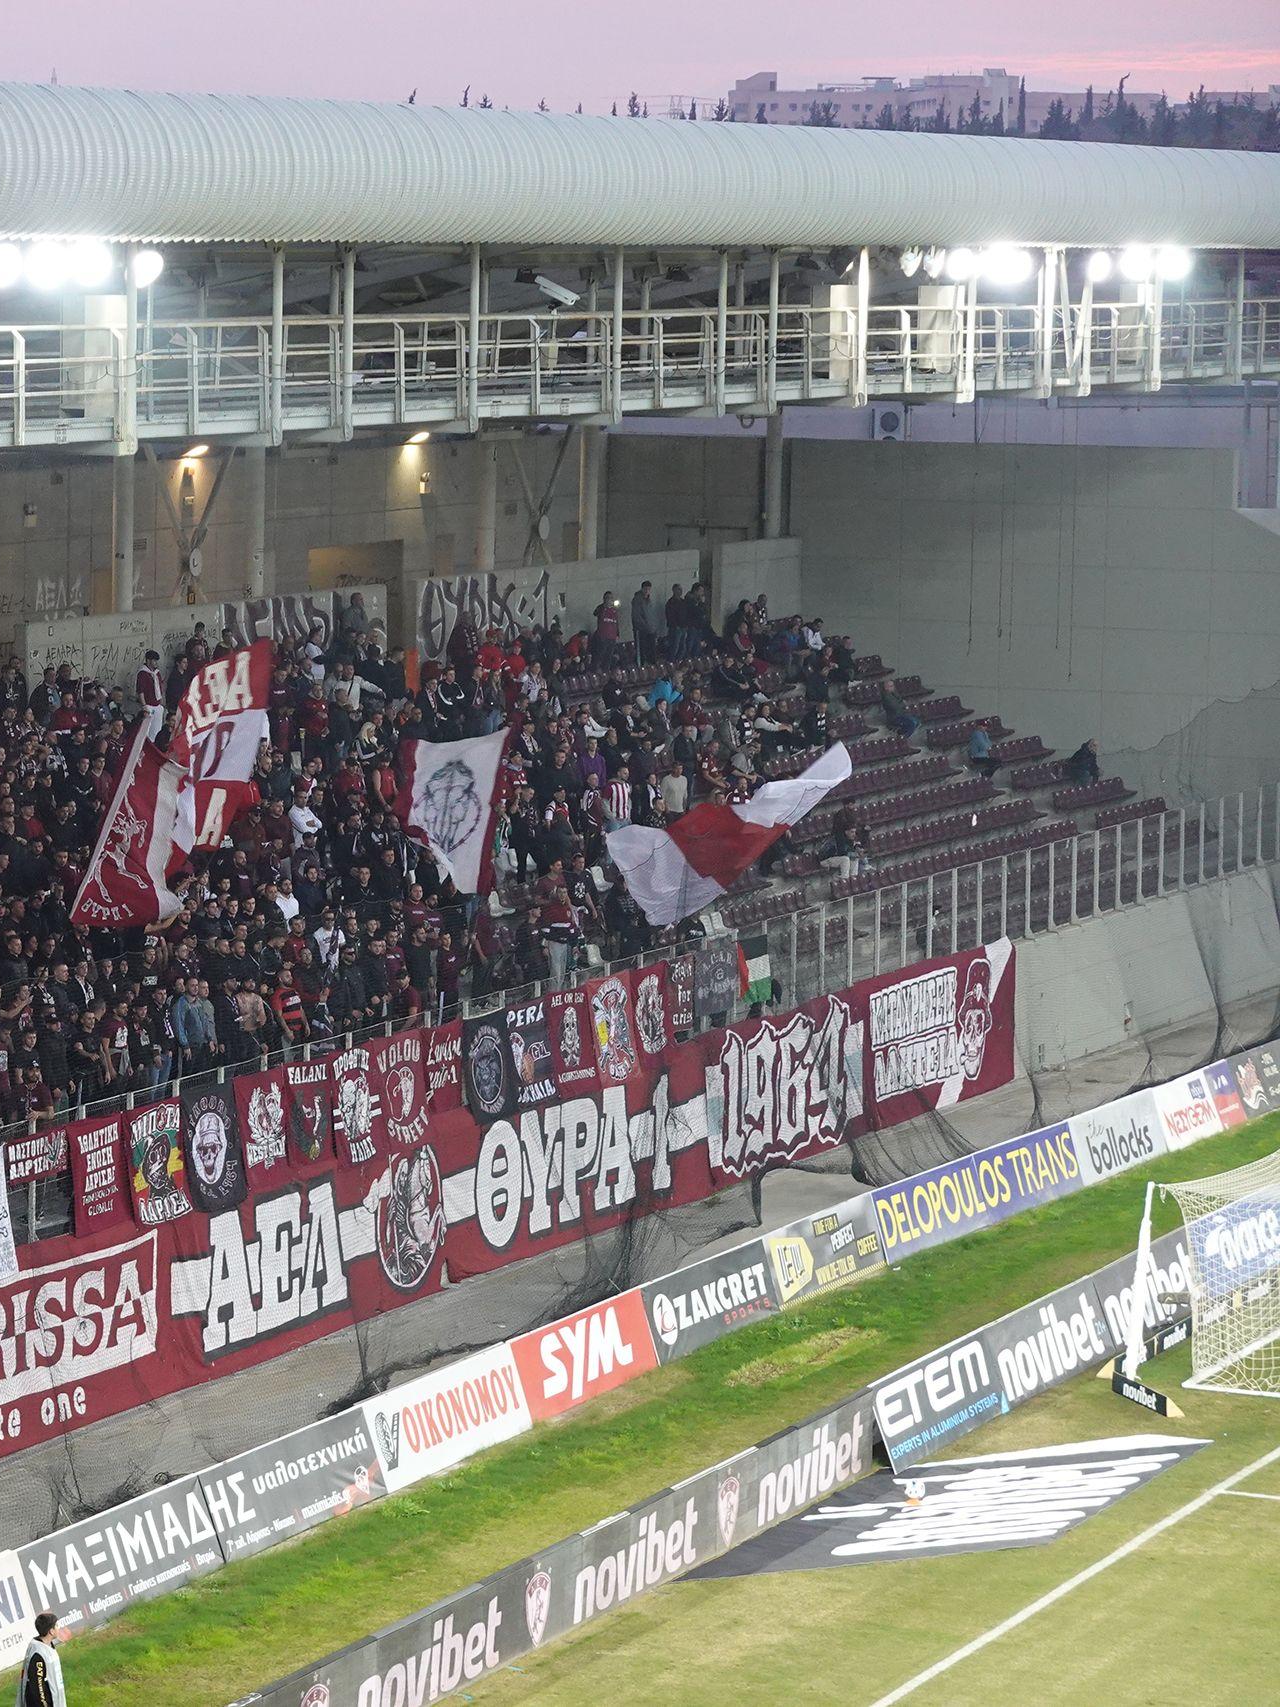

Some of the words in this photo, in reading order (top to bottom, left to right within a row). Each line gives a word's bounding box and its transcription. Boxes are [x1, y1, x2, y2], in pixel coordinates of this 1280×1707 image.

[721, 996, 851, 1176] 1964
[875, 1158, 1012, 1249] DELOPOULOS
[1007, 1131, 1079, 1197] TRANS
[1086, 1118, 1154, 1175] bollocks
[202, 1181, 348, 1353] ΑΕΛ
[673, 1263, 767, 1330] ZAKCRET
[723, 1297, 771, 1325] SPORTS
[540, 1306, 633, 1400] SYM
[874, 1340, 991, 1439] ETEM
[997, 1292, 1105, 1402] novibet
[1123, 1383, 1157, 1411] novibet
[40, 1385, 87, 1426] one
[891, 1433, 922, 1460] EXPERTS
[930, 1404, 970, 1439] ALUMINIUM
[969, 1392, 999, 1418] SYSTEMS
[28, 1471, 258, 1612] ΜΑΞΙΜΙΑΔΗΣ
[252, 1428, 369, 1496] υαλοτεχνική
[757, 1410, 864, 1528] novibet
[574, 1497, 699, 1625] novibet
[357, 1595, 502, 1707] novibet
